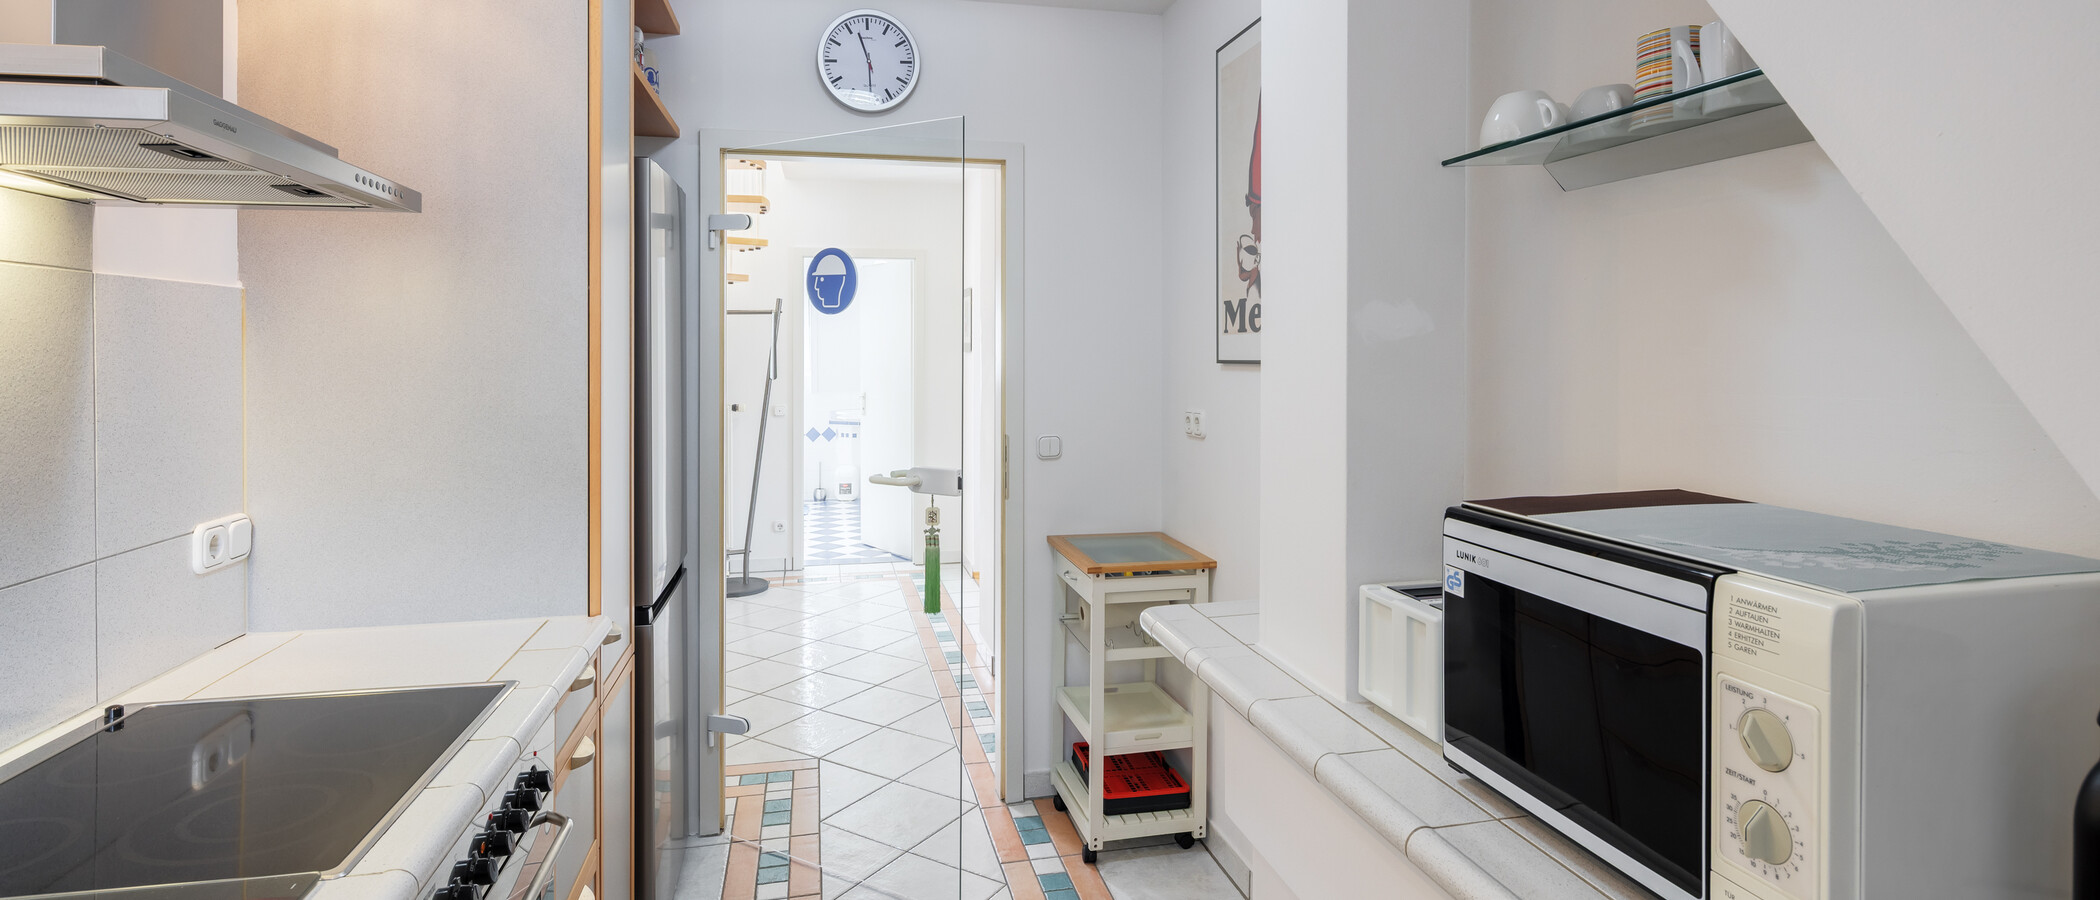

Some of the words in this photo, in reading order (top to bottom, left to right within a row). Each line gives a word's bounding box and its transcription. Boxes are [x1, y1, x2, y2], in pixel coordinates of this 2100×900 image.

[1456, 549, 1476, 564] LUNIK
[1736, 597, 1778, 613] ANWÄRMEN
[1735, 609, 1769, 624] AUFTAUEN
[1735, 621, 1780, 639] WARMHALTEN
[1734, 633, 1764, 647] ERHITZEN
[1734, 644, 1757, 656] GAREN
[1725, 684, 1754, 699] LEISTUNG
[1725, 768, 1756, 786] ZEIT/START
